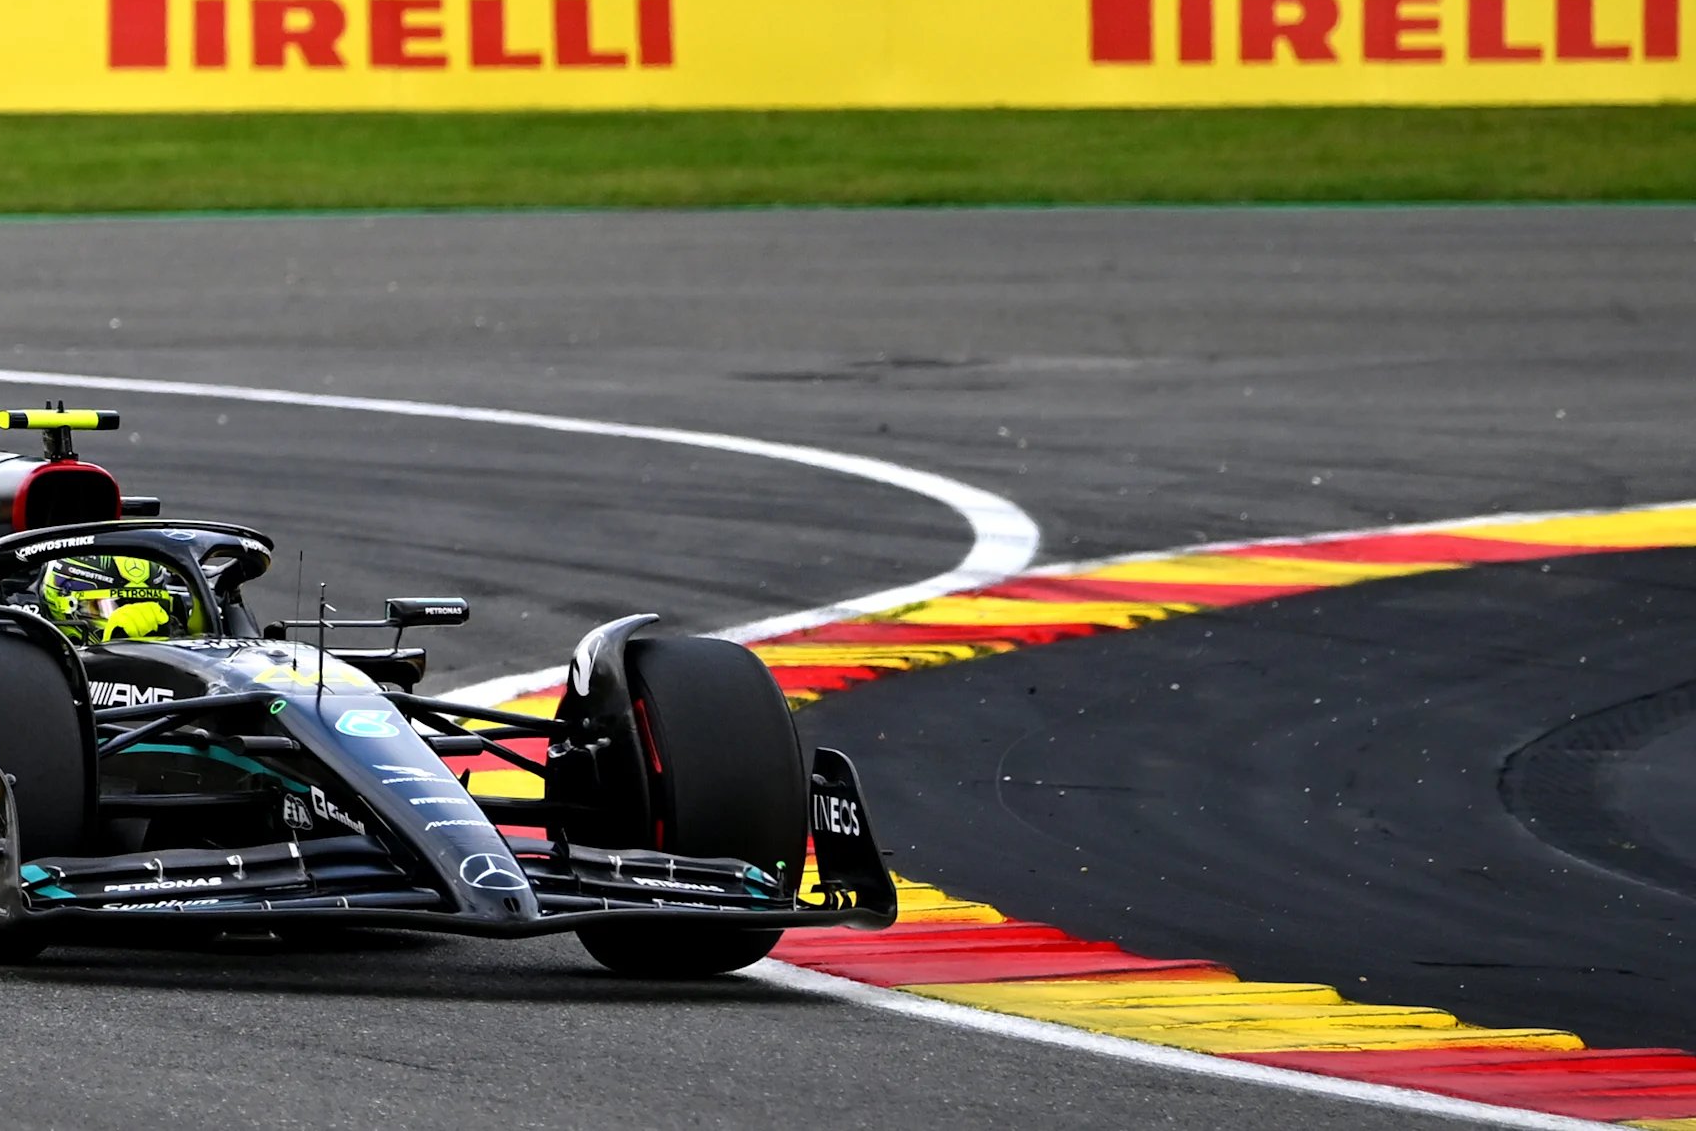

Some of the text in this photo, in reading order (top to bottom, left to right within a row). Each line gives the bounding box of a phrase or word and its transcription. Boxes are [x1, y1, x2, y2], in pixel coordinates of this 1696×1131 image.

[18, 535, 95, 559] CROWDSTRIKE
[68, 566, 115, 584] CROWDSTRIKE
[109, 589, 163, 599] PETRONAS
[424, 607, 462, 615] PETRONAS
[284, 800, 311, 825] FIA
[326, 801, 366, 836] Einhell
[813, 794, 860, 836] INEOS
[104, 877, 222, 892] PETRONAS
